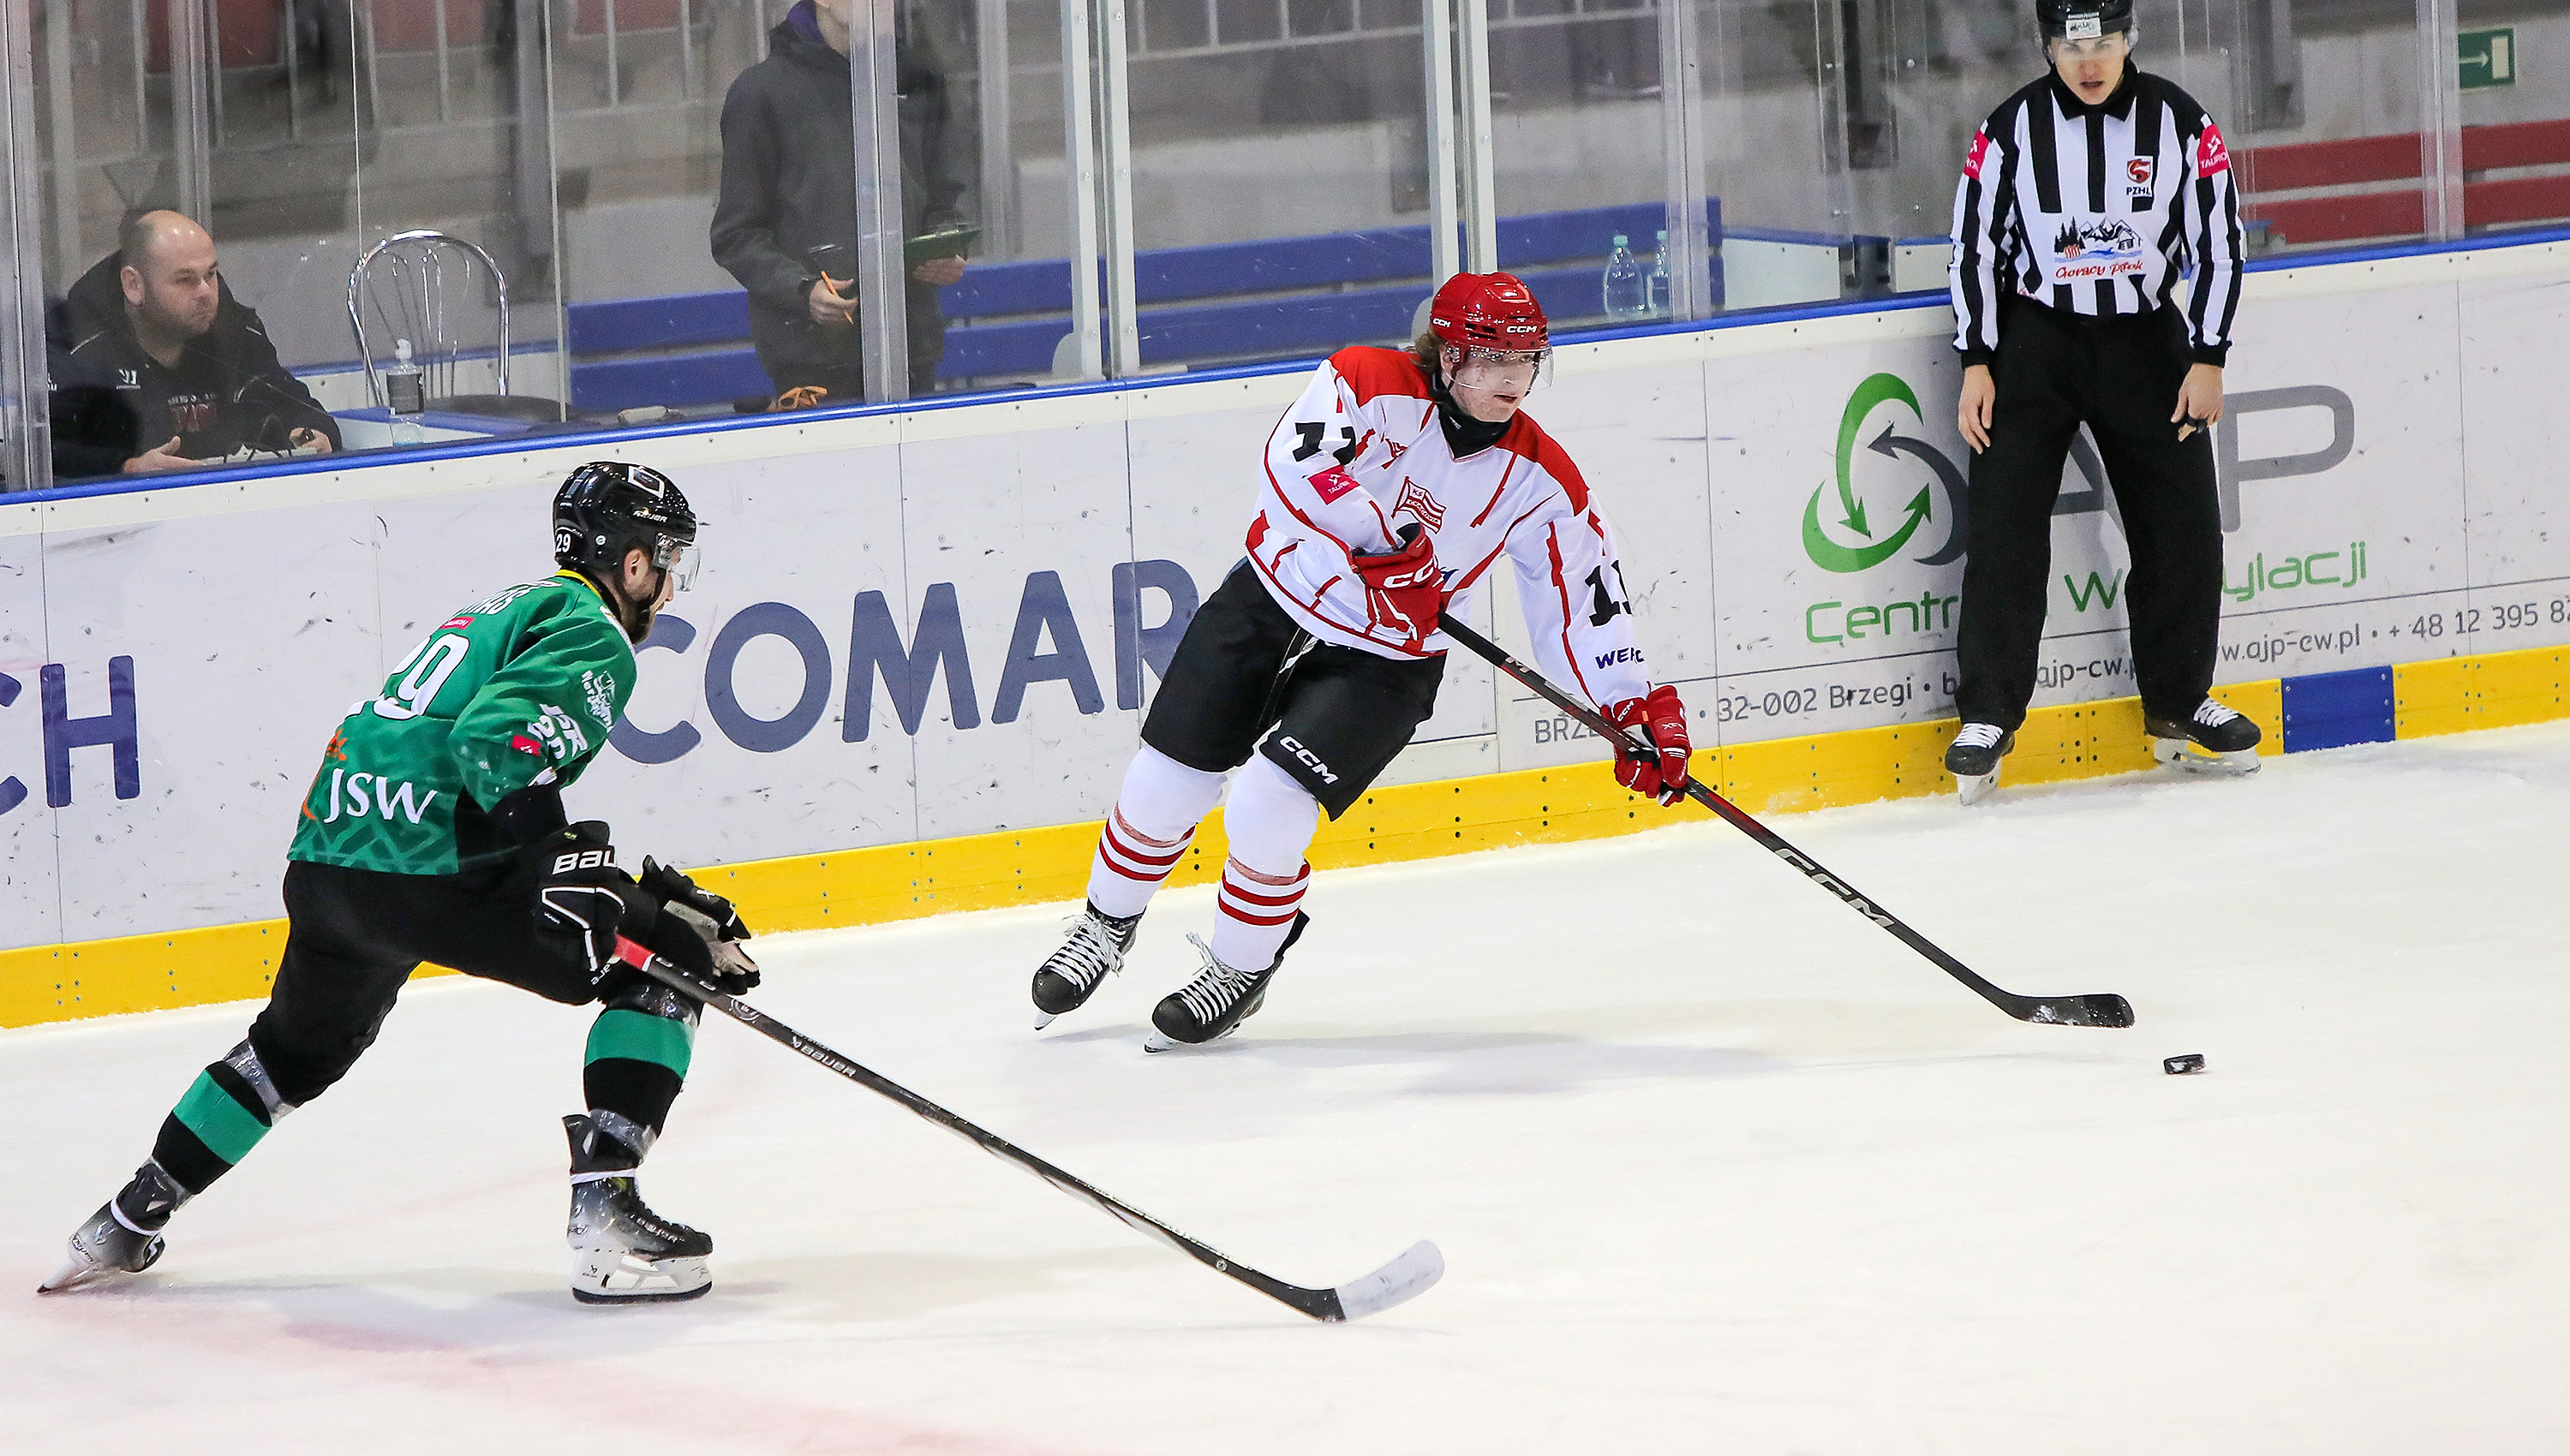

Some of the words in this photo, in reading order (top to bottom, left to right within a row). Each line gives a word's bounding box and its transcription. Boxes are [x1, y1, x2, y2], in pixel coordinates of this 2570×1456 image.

[2126, 187, 2151, 195] PZHL
[1432, 318, 1451, 327] CCM
[557, 533, 571, 552] 29
[1383, 558, 1437, 588] CC
[1805, 591, 1959, 643] Centr
[1718, 688, 1818, 722] 32-002
[1830, 677, 1912, 707] Brzegi
[2221, 624, 2360, 663] w.ajp-cw.pl
[2412, 613, 2443, 638] 48
[2455, 609, 2480, 634] 12
[2492, 602, 2538, 630] 395
[2550, 599, 2570, 624] 8
[1617, 700, 1634, 721] CCM
[1279, 736, 1339, 785] CCM
[323, 768, 439, 825] JSW
[1775, 848, 1895, 928] CCM
[800, 1044, 857, 1077] BAUER
